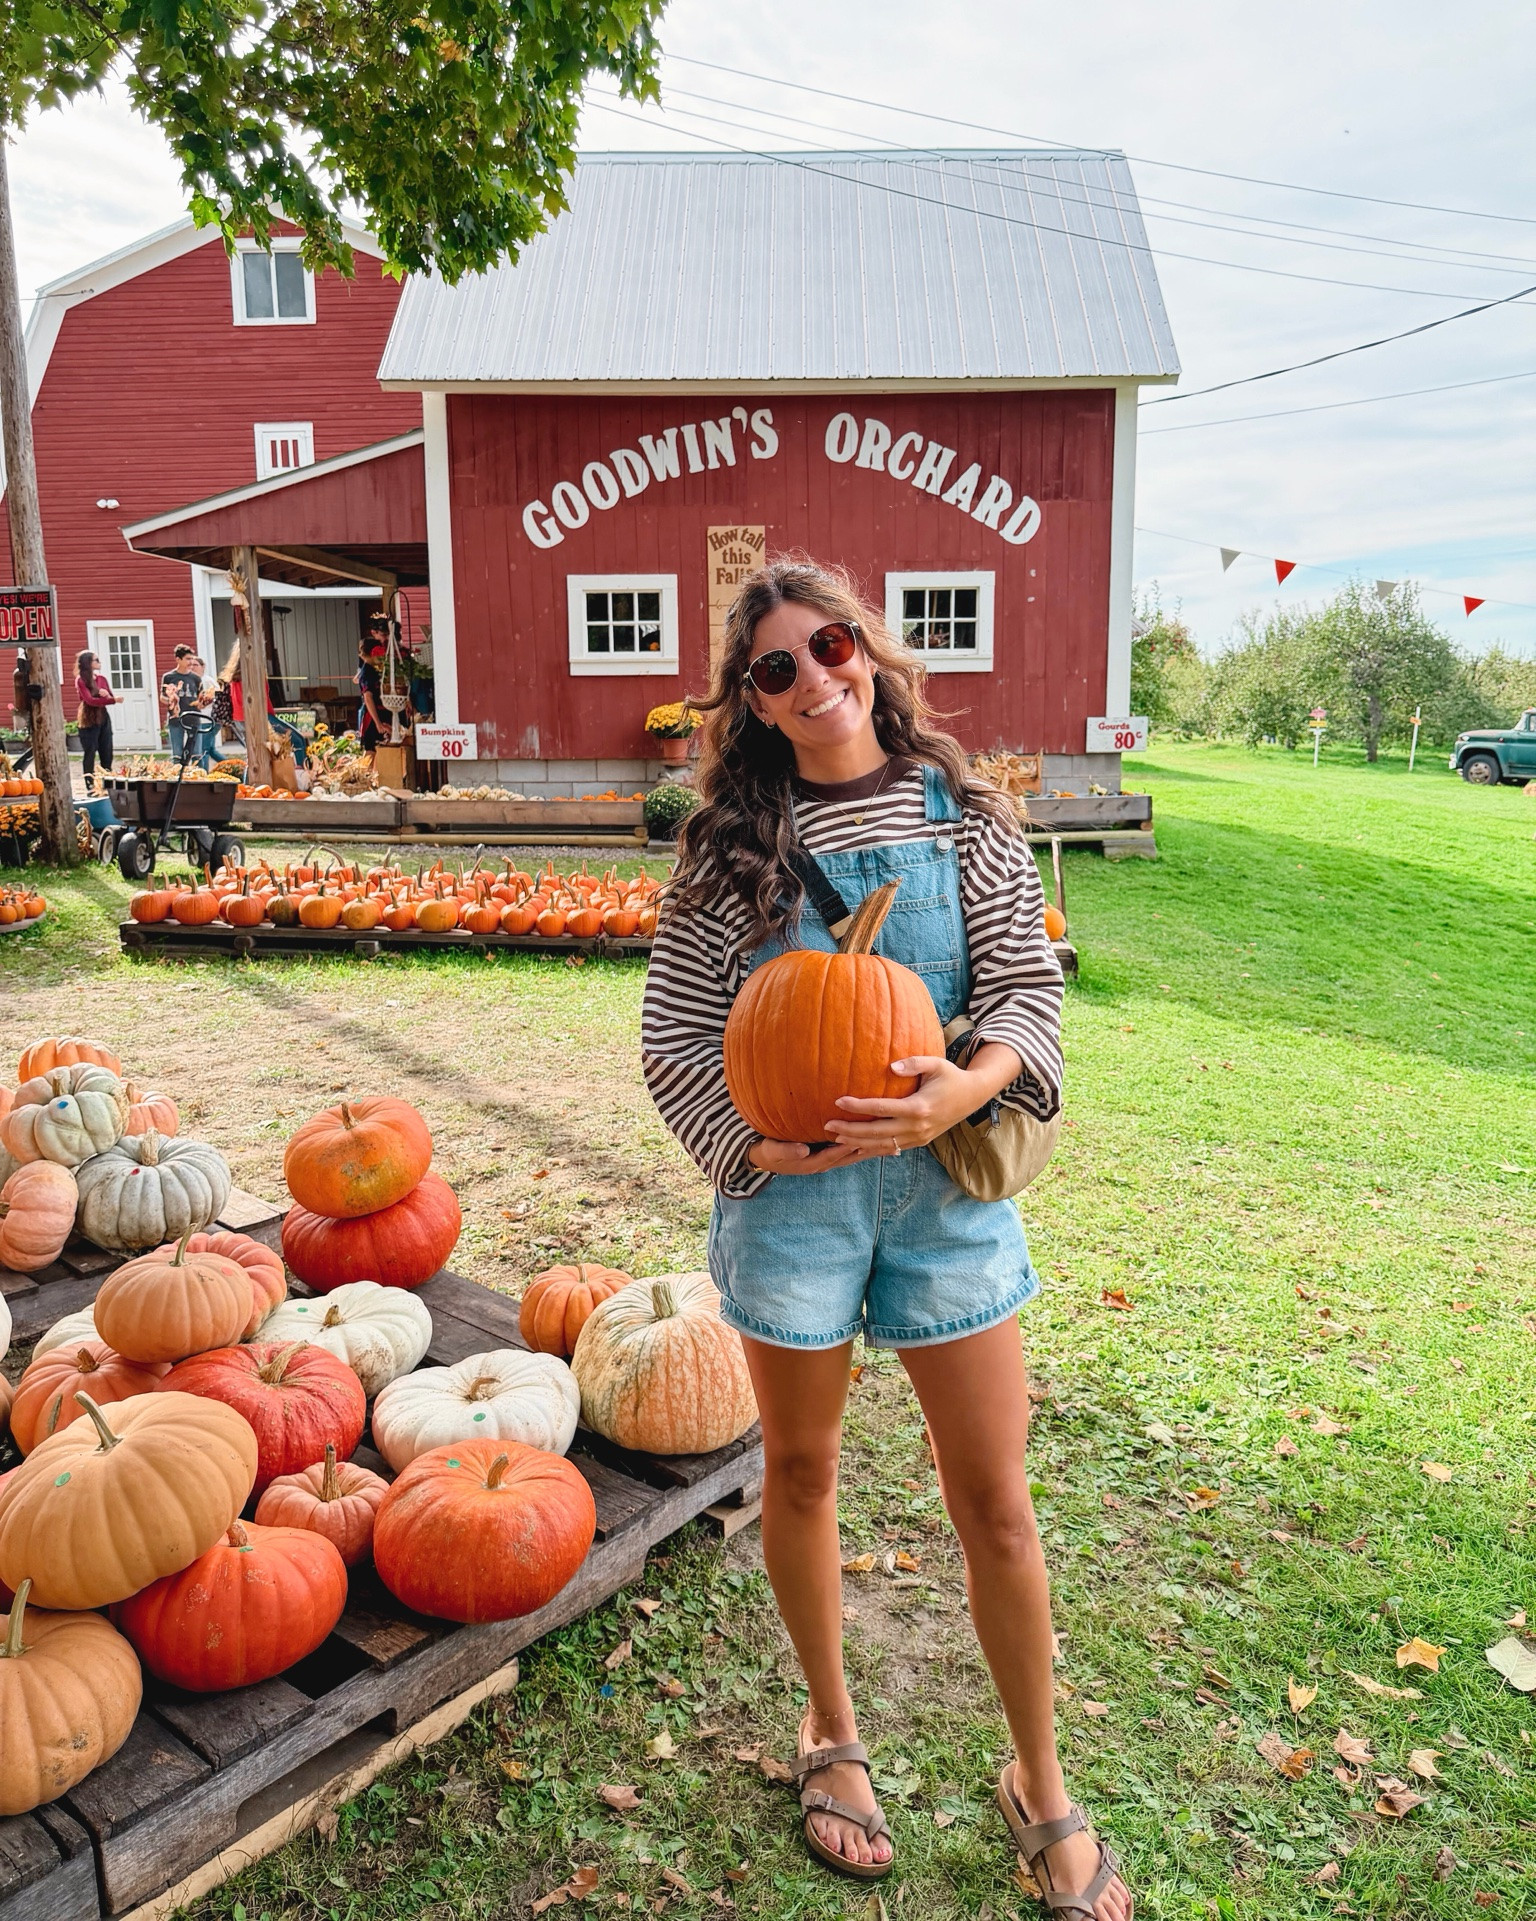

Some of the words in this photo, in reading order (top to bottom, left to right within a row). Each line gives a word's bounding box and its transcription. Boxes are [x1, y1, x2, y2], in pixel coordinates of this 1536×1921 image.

[522, 406, 779, 549] GOODWIN'S
[825, 412, 1042, 545] ORCHARD
[708, 528, 739, 551] How
[741, 527, 765, 552] tall
[722, 547, 752, 565] this
[20, 593, 49, 603] WE'RE
[0, 606, 53, 641] OPEN
[421, 728, 465, 737] Bumpkins
[1098, 722, 1130, 730] Gourds
